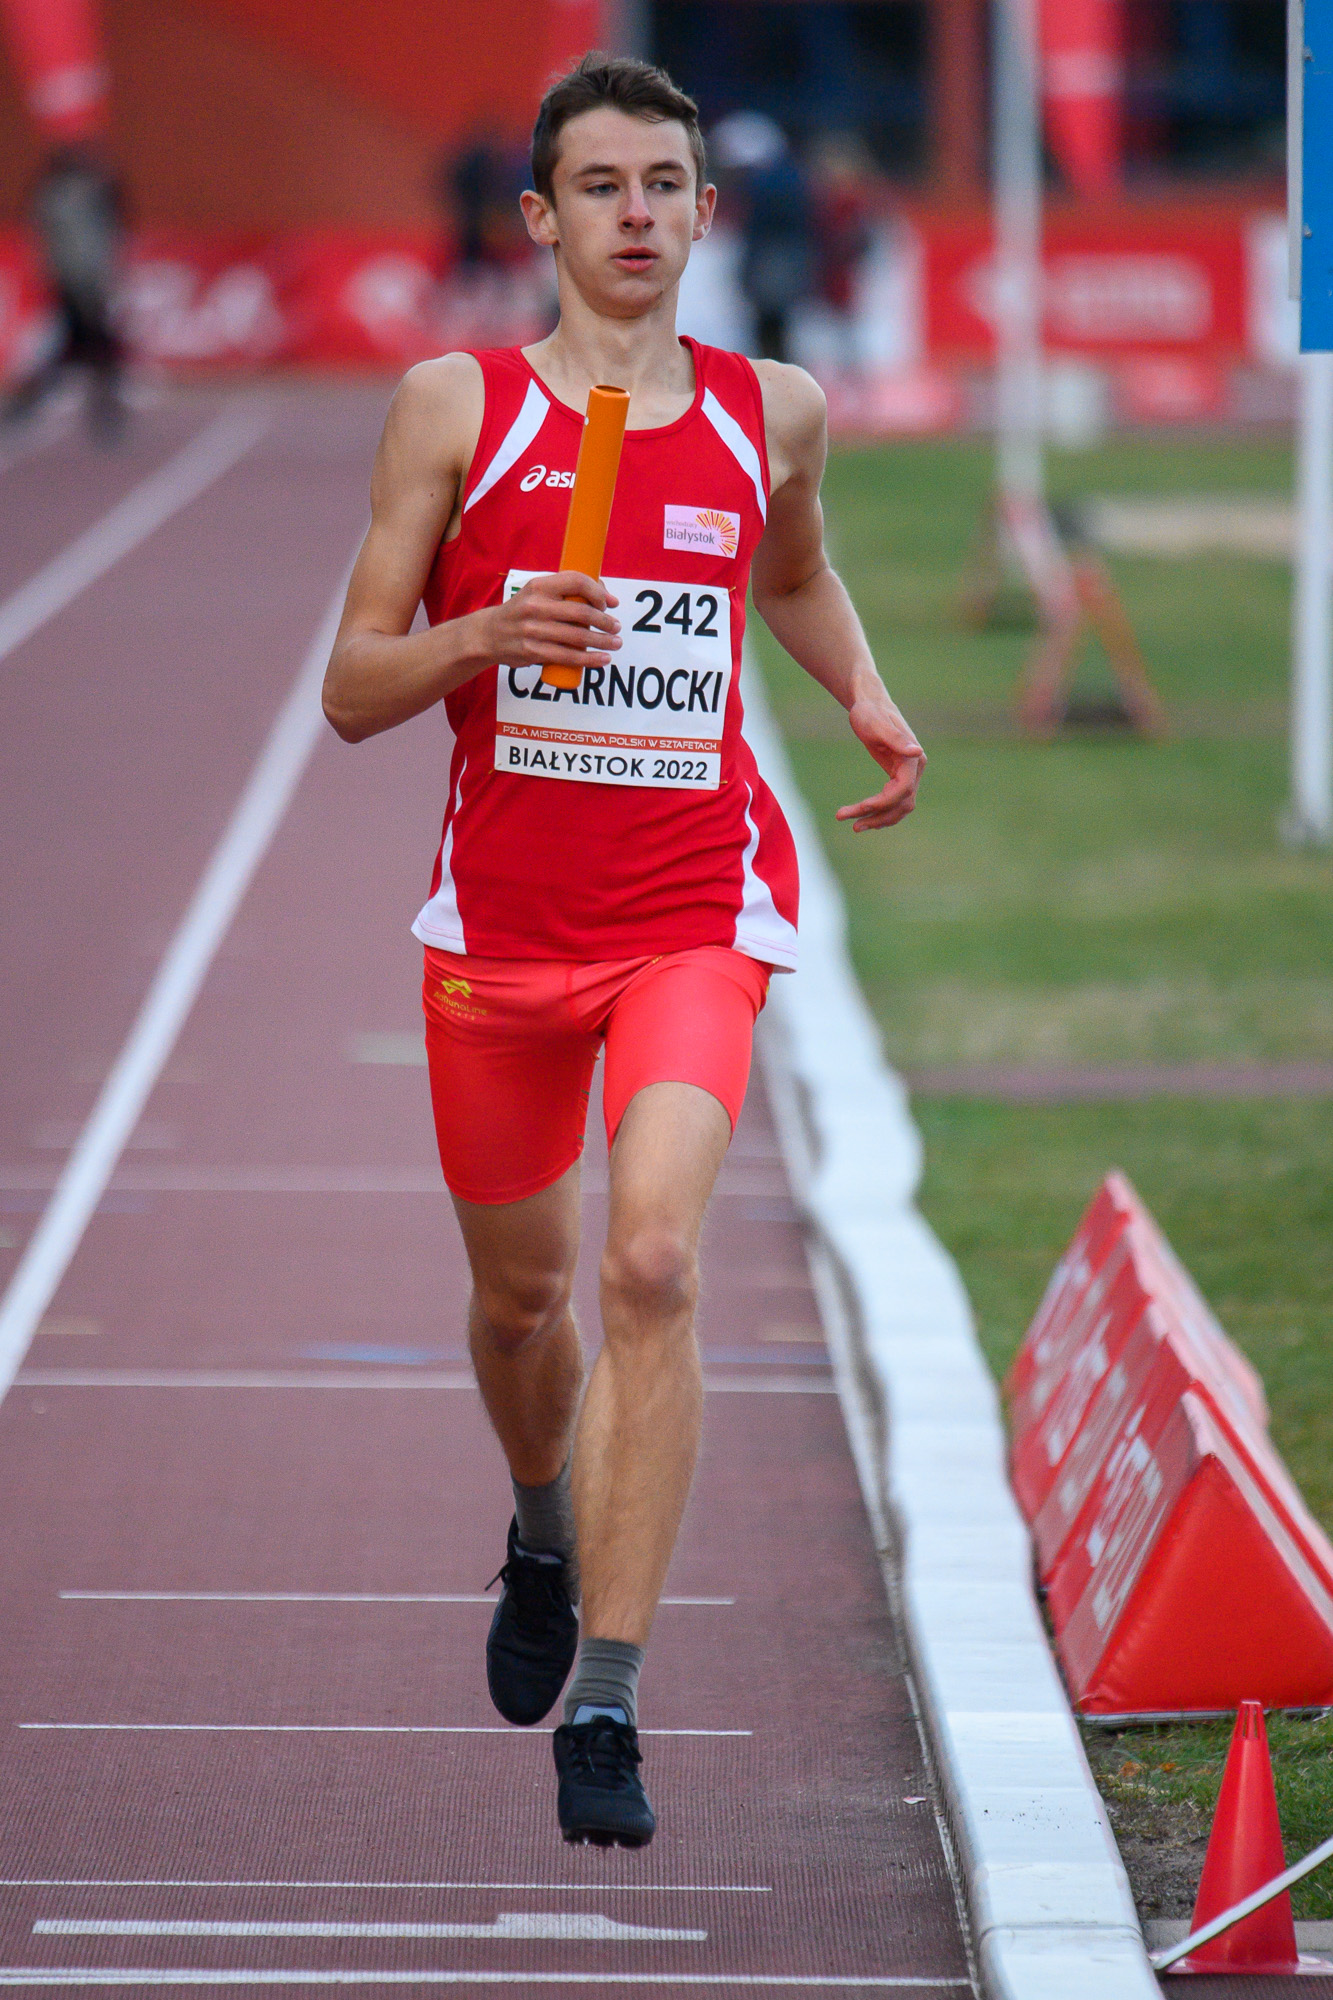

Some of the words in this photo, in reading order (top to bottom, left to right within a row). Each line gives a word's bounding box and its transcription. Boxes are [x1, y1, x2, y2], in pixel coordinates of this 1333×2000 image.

[632, 589, 719, 638] 242
[503, 725, 529, 737] PZLA
[530, 729, 607, 744] MISTRZOSTWA
[609, 736, 646, 747] POLSKI
[648, 739, 658, 748] W
[659, 740, 717, 751] SZTAFETACH
[509, 745, 645, 778] BIAŁYSTOK
[652, 759, 708, 781] 2022
